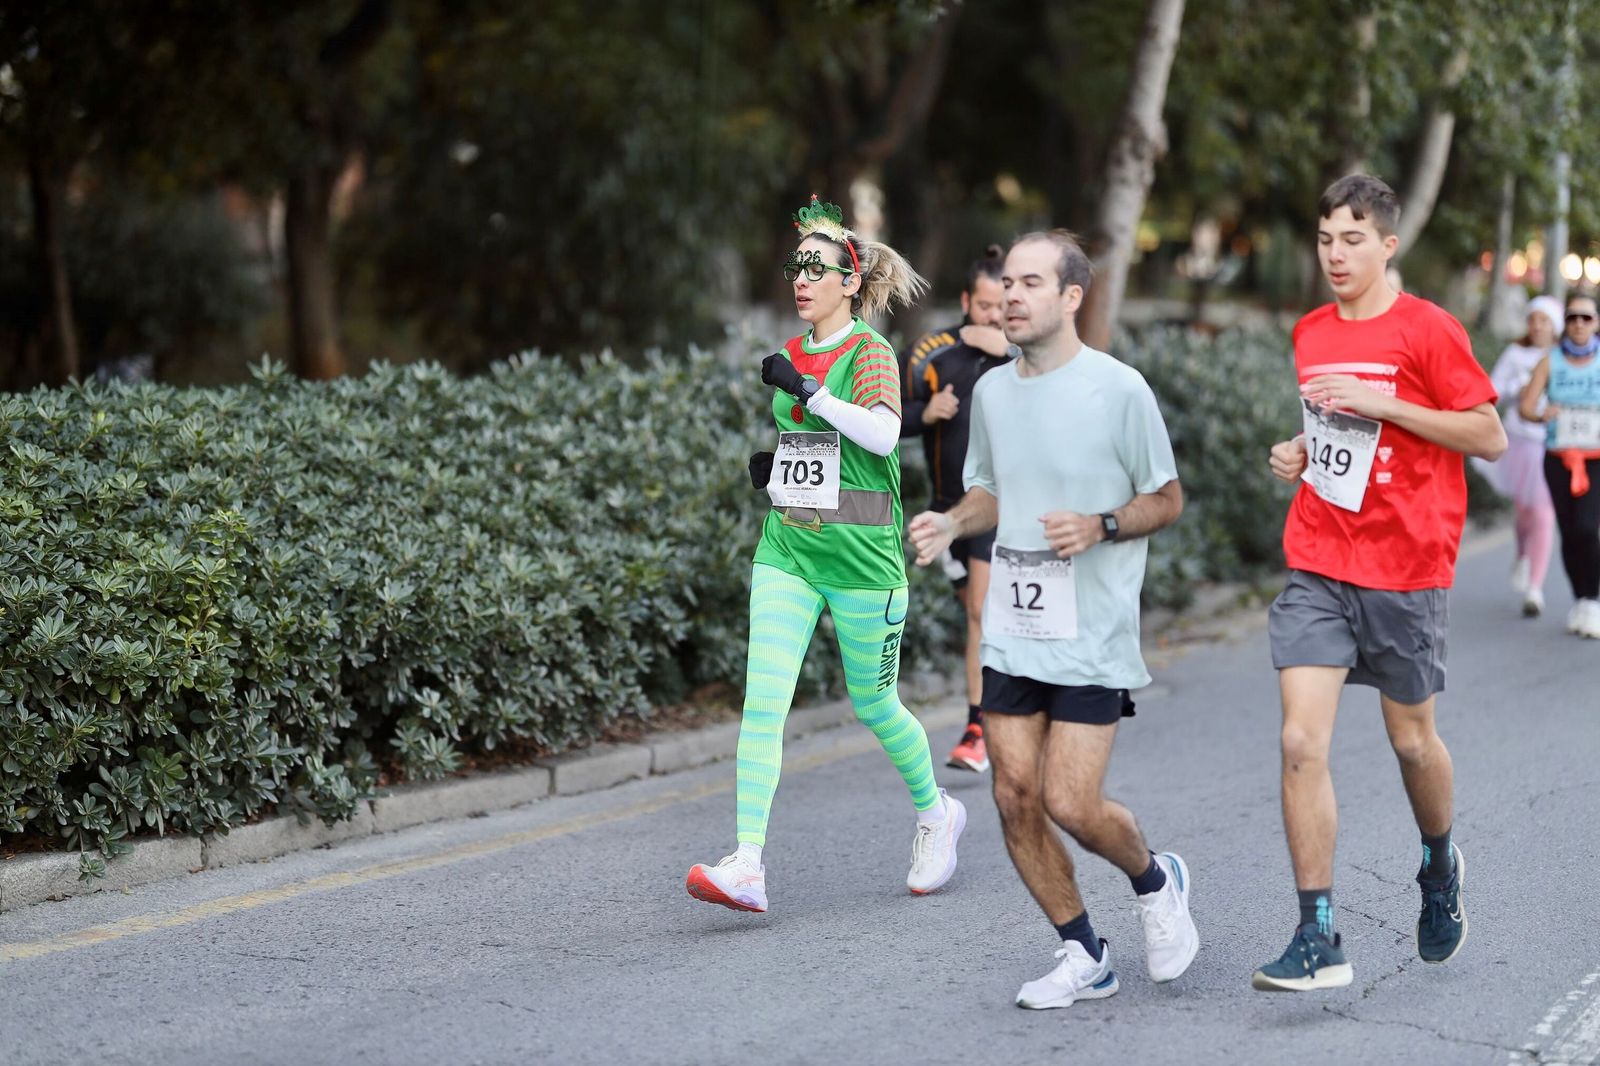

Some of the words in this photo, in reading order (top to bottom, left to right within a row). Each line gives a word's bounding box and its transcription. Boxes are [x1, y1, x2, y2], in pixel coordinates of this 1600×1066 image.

[780, 460, 825, 486] 703
[1310, 436, 1352, 477] 149
[1010, 581, 1045, 610] 12
[877, 629, 902, 692] HANKER
